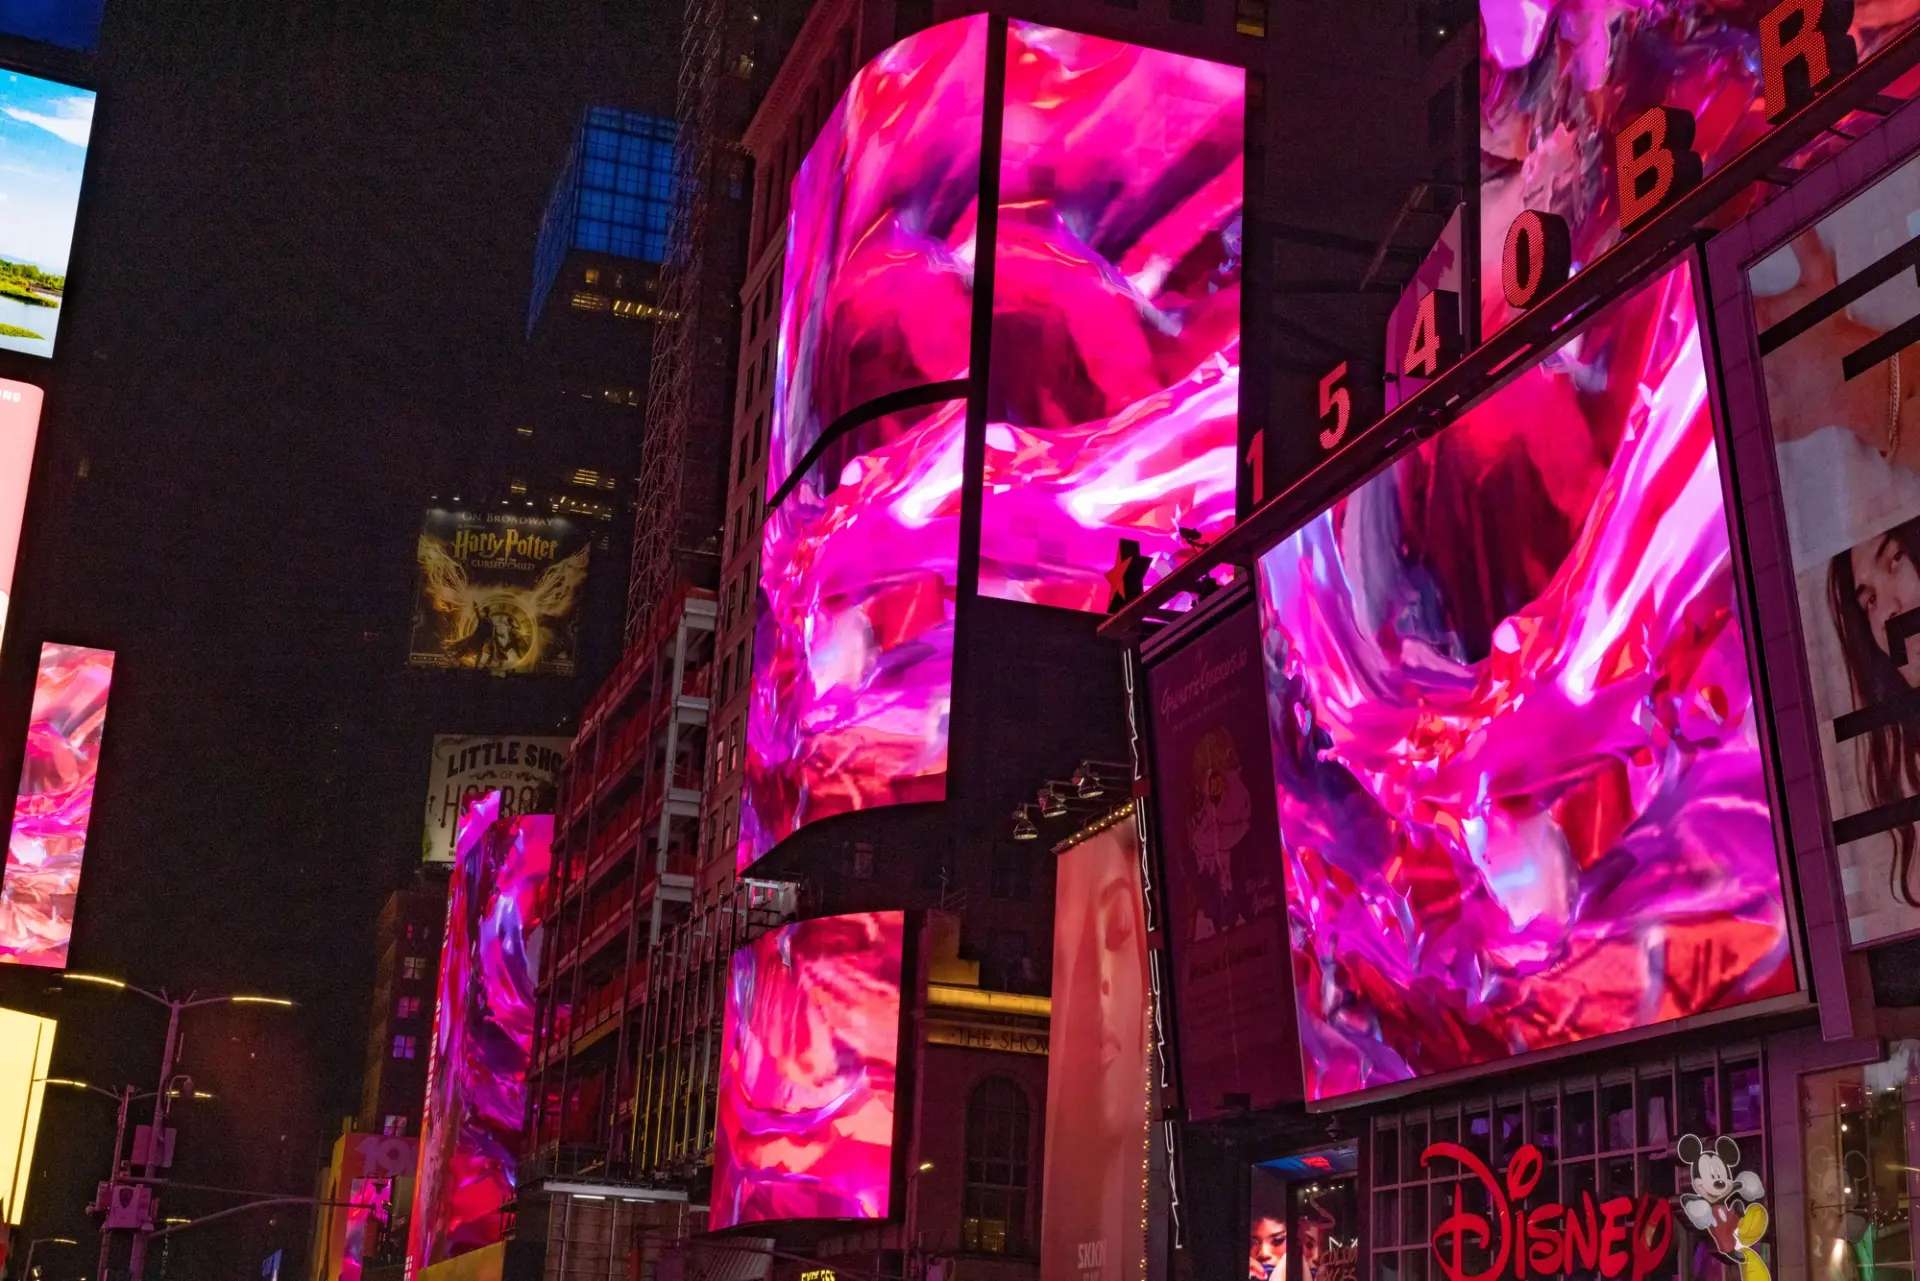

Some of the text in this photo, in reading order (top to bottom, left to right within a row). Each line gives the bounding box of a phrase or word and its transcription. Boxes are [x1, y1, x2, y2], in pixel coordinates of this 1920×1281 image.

[1244, 209, 1546, 506] 1540
[486, 512, 554, 526] BROADWAY
[452, 528, 560, 563] Harry Potter
[471, 559, 505, 570] CURSED
[447, 741, 521, 778] LITTLE
[955, 1026, 992, 1047] THE
